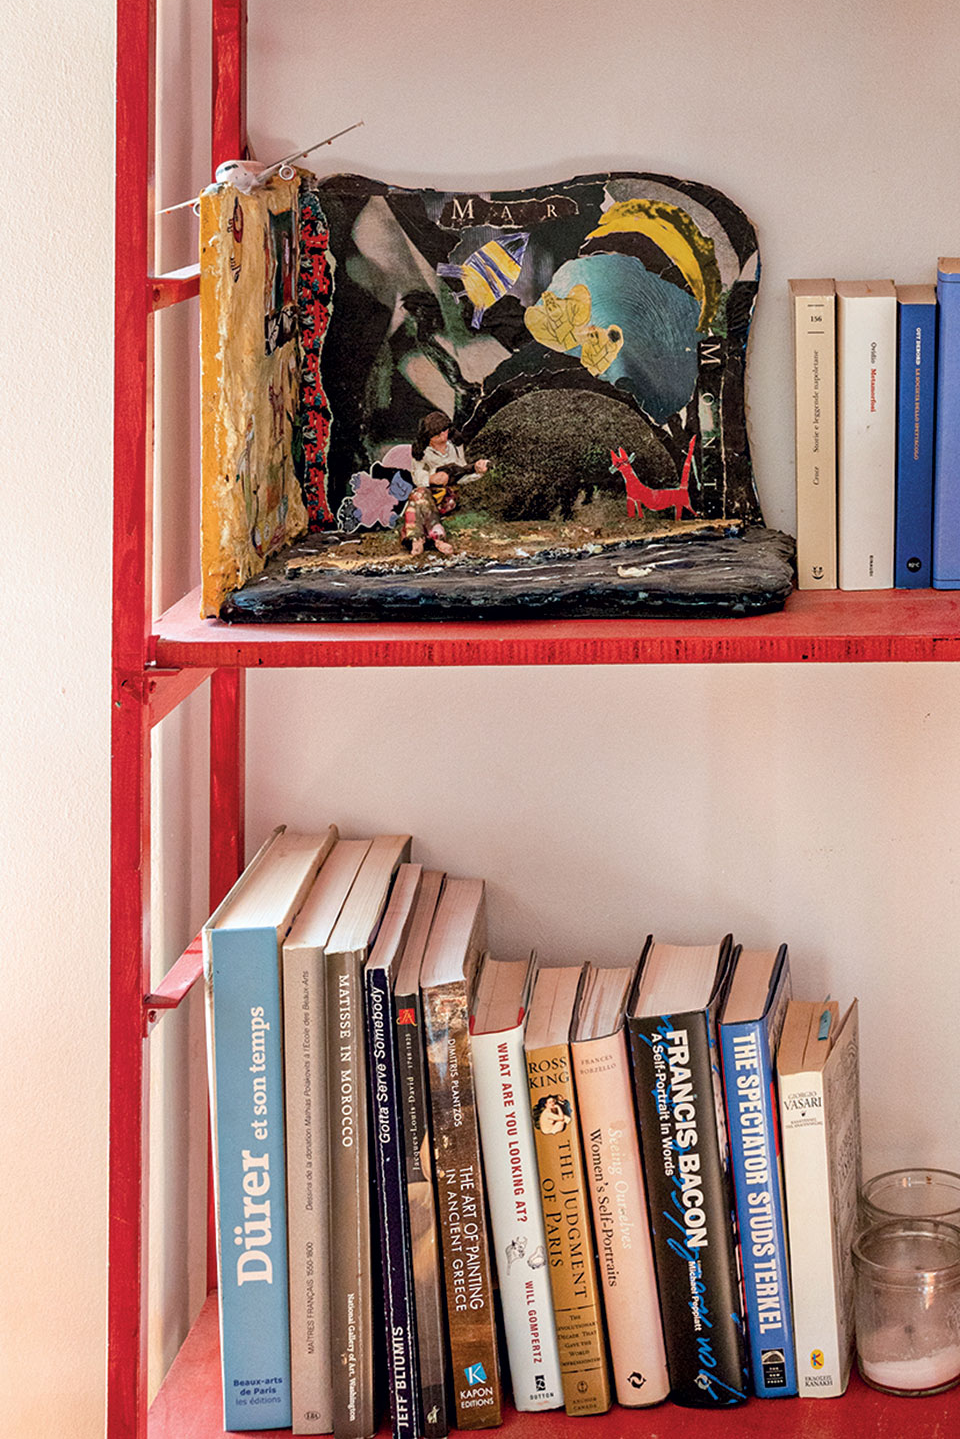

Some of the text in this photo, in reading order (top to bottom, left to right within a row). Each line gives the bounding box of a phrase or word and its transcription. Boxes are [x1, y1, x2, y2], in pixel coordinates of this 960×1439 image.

[811, 351, 821, 389] napoletane
[812, 390, 822, 425] leggende
[869, 342, 878, 412] Ovidio Metamorfosi
[812, 432, 820, 453] Storie
[812, 466, 820, 486] Croce
[338, 973, 353, 1147] MATISSE IN MOROCCO
[447, 1038, 462, 1127] DIMITRIS PLANTZOS
[528, 1056, 568, 1074] ROSS
[529, 1071, 570, 1089] KING
[734, 1032, 758, 1070] THE
[233, 1007, 273, 1287] Dürer et son temps
[497, 1042, 527, 1223] WHAT ARE YOU LOOKING AT?
[666, 1029, 708, 1248] FRANCIS BACON
[737, 1075, 768, 1187] SPECTATOR
[460, 1166, 483, 1310] THE ART OF PAINTING
[541, 1178, 564, 1267] OF PARIS
[557, 1139, 587, 1299] THE JUDGMENT
[748, 1192, 776, 1257] STUDS
[525, 1280, 542, 1364] WILL GOMPERTZ
[754, 1259, 782, 1334] TERKEL
[460, 1387, 493, 1400] KAPON
